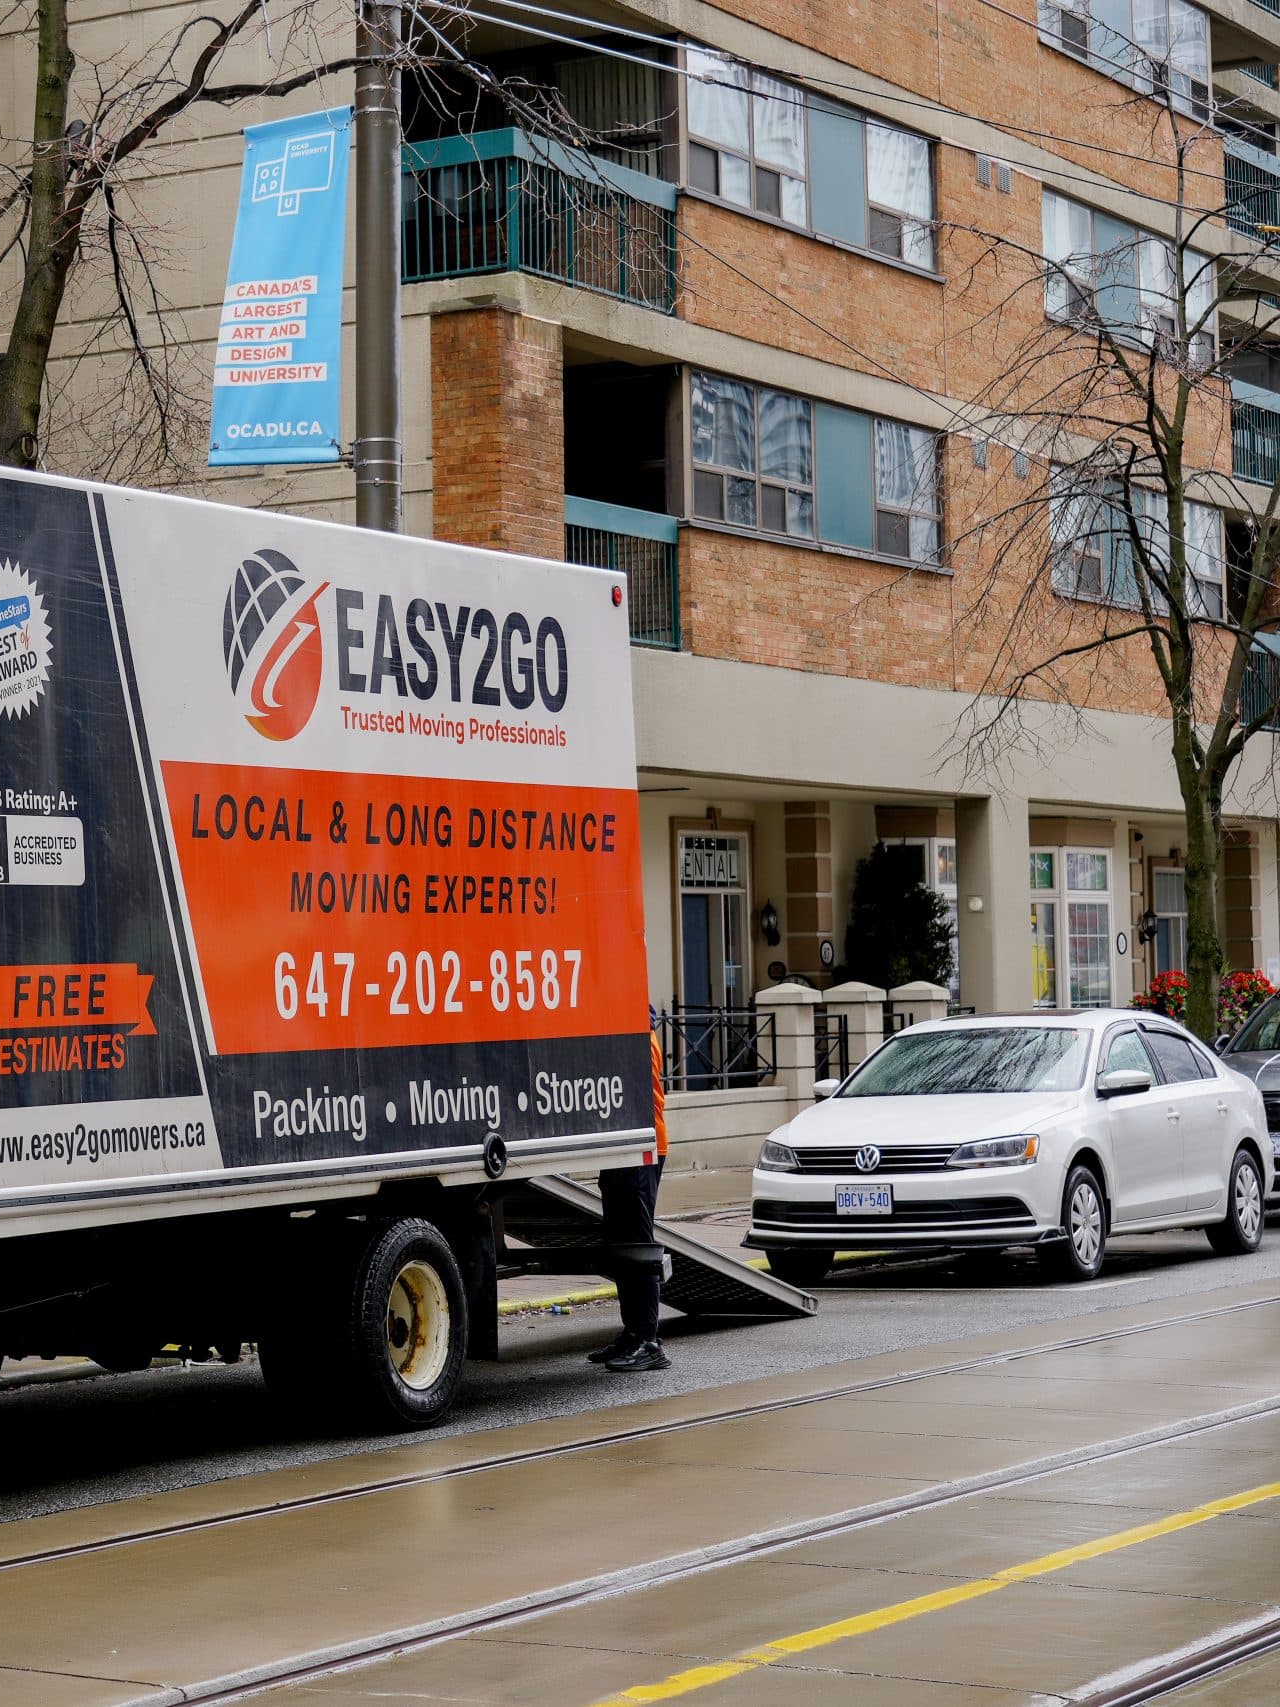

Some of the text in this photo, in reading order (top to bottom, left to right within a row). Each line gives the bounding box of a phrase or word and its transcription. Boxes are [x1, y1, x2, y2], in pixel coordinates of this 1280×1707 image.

[237, 279, 312, 297] CANADA'S
[234, 302, 302, 318] LARGEST
[232, 324, 300, 340] ART AND
[230, 345, 287, 361] DESIGN
[230, 366, 324, 383] UNIVERSITY
[227, 421, 323, 439] OCADU.CA
[20, 624, 31, 651] of
[335, 588, 569, 713] EASY2GO
[340, 706, 567, 747] Trusted Moving Professionals
[5, 788, 55, 815] Rating:
[58, 790, 78, 811] A+
[191, 793, 616, 853] LOCAL & LONG DISTANCE
[14, 835, 77, 850] ACCREDITED
[14, 851, 63, 865] BUSINESS
[289, 872, 557, 914] MOVING EXPERTS!
[13, 974, 106, 1018] FREE
[274, 949, 582, 1020] 647-202-8587
[253, 1070, 623, 1142] Packing Moving Storage
